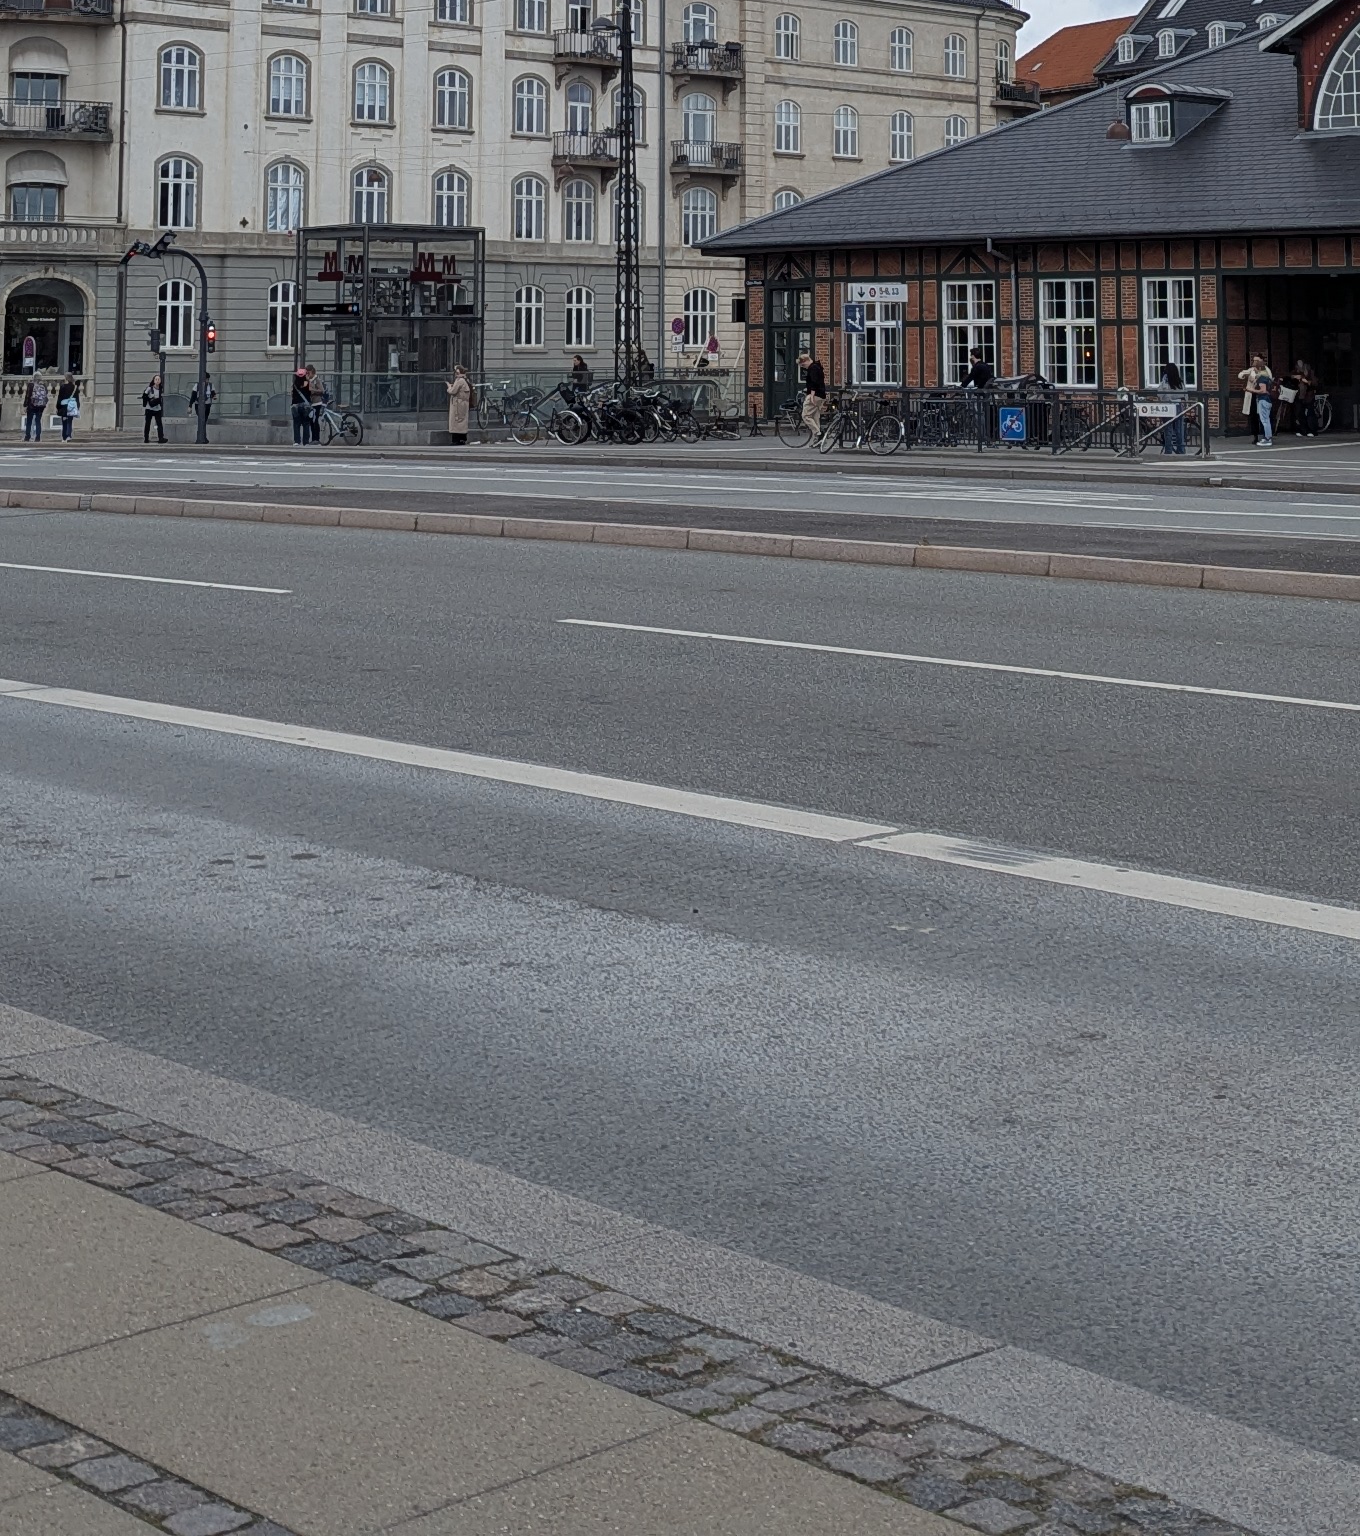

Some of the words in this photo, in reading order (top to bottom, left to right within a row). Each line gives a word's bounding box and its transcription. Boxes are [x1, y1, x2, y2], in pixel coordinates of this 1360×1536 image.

[324, 252, 337, 272] M
[419, 252, 435, 272] M
[443, 255, 455, 274] M
